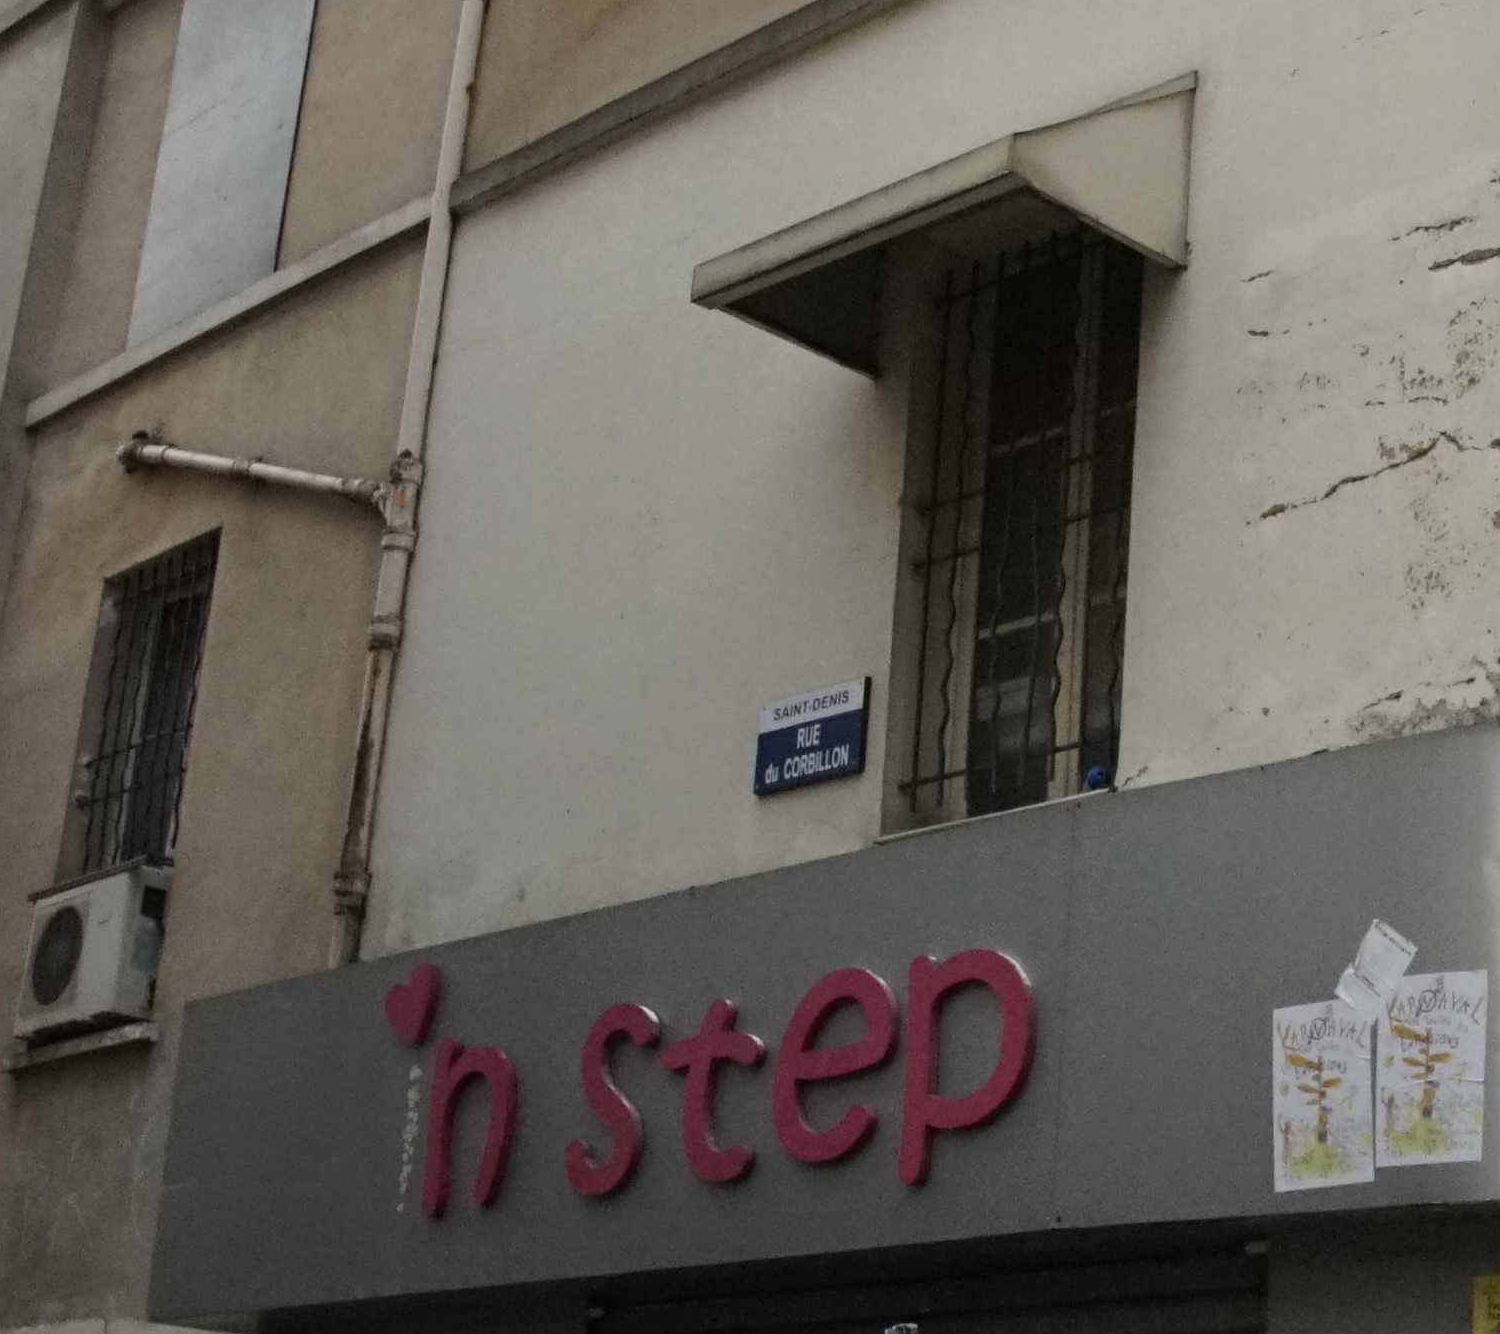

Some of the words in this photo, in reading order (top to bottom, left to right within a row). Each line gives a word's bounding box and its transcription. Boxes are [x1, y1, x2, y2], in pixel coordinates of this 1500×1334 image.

[773, 690, 850, 721] SAINT-DENIS
[796, 724, 821, 749] RUE
[764, 763, 779, 784] du
[783, 744, 850, 780] CORBILLON
